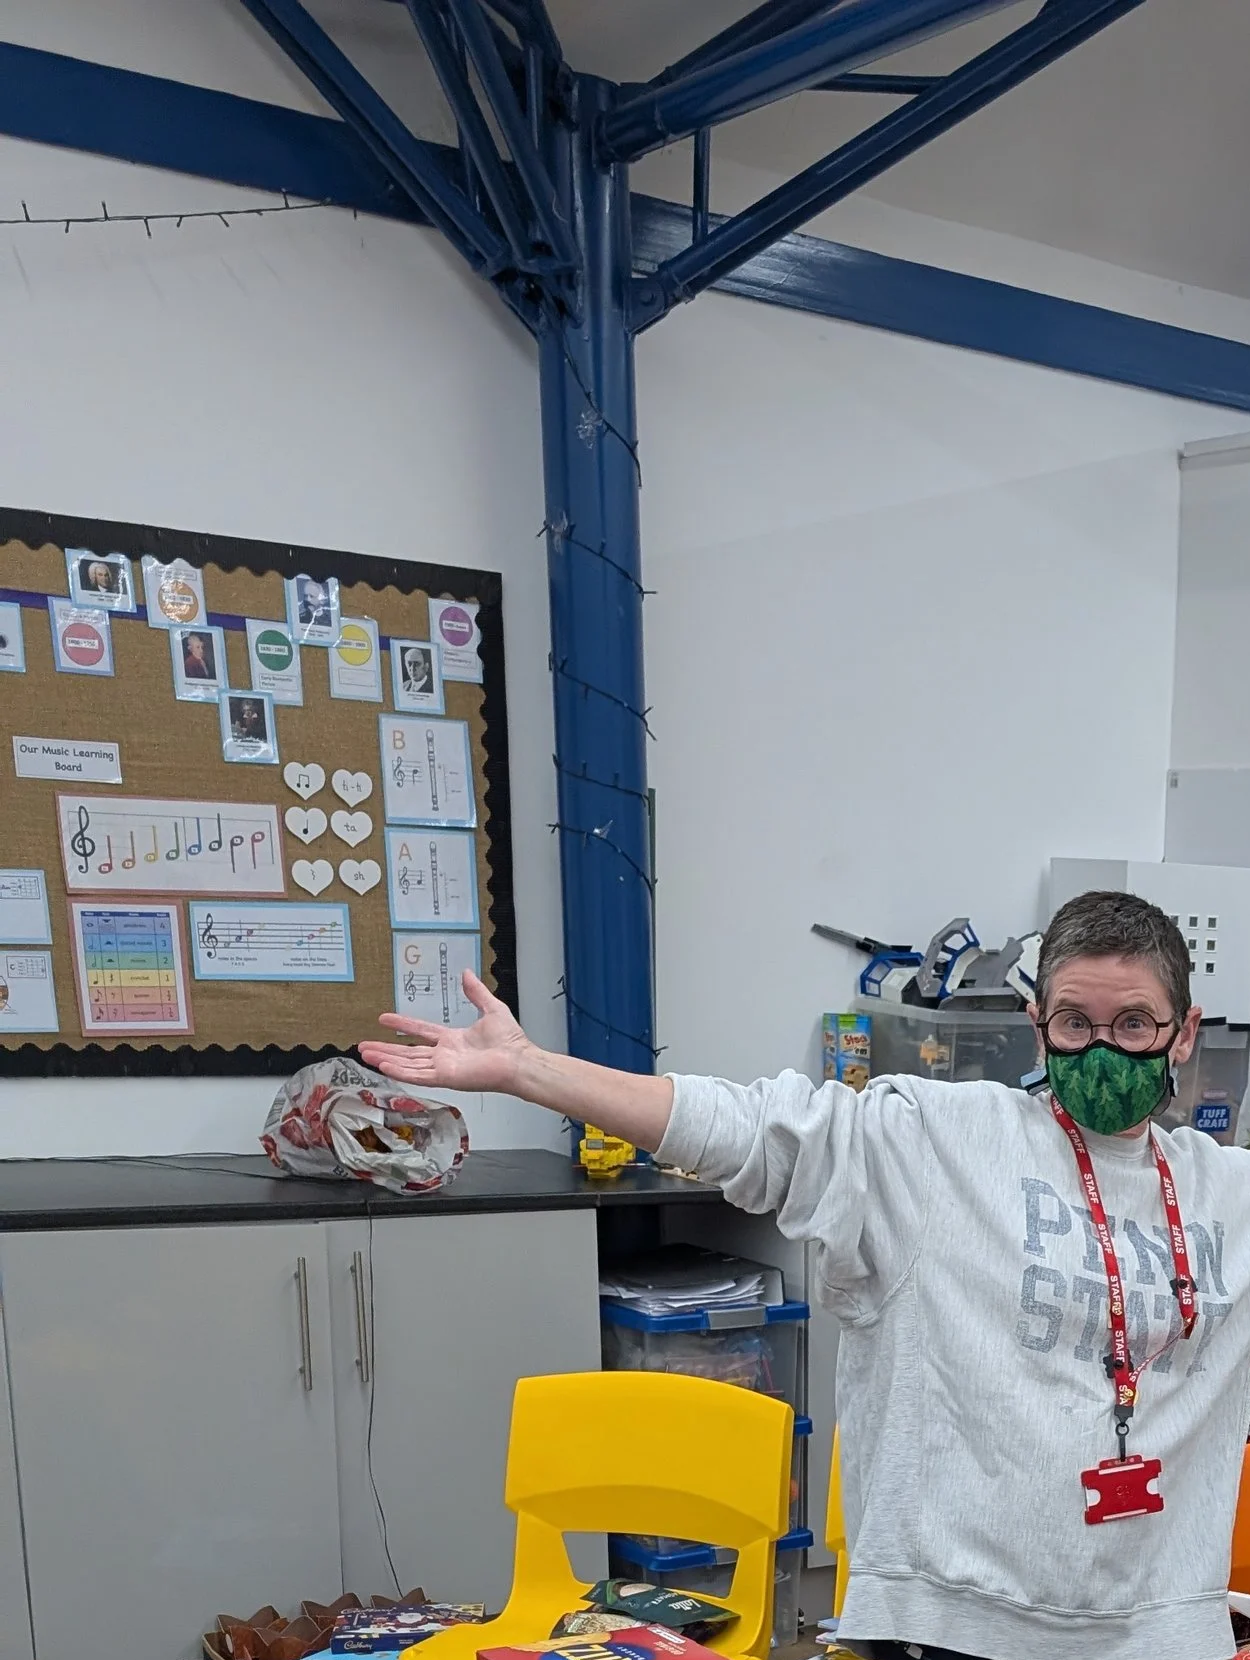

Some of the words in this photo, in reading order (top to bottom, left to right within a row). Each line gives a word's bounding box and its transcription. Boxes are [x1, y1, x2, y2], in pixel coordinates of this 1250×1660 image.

[393, 730, 405, 749] B
[20, 744, 38, 754] Our
[42, 746, 69, 756] Music
[73, 748, 114, 761] Learning
[55, 762, 82, 772] Board
[344, 822, 357, 832] ta
[399, 843, 412, 861] A
[354, 872, 365, 881] sh
[404, 945, 421, 964] G
[843, 1034, 868, 1045] Stack
[1202, 1109, 1227, 1118] TUFF
[1197, 1118, 1229, 1128] CRATE
[1067, 1128, 1086, 1155] STAFF
[1083, 1173, 1099, 1204] STAFF
[1163, 1176, 1176, 1207] STAFF
[1097, 1223, 1113, 1255] STAFF
[1171, 1224, 1185, 1255] STAFF
[343, 1640, 373, 1650] Cadbury
